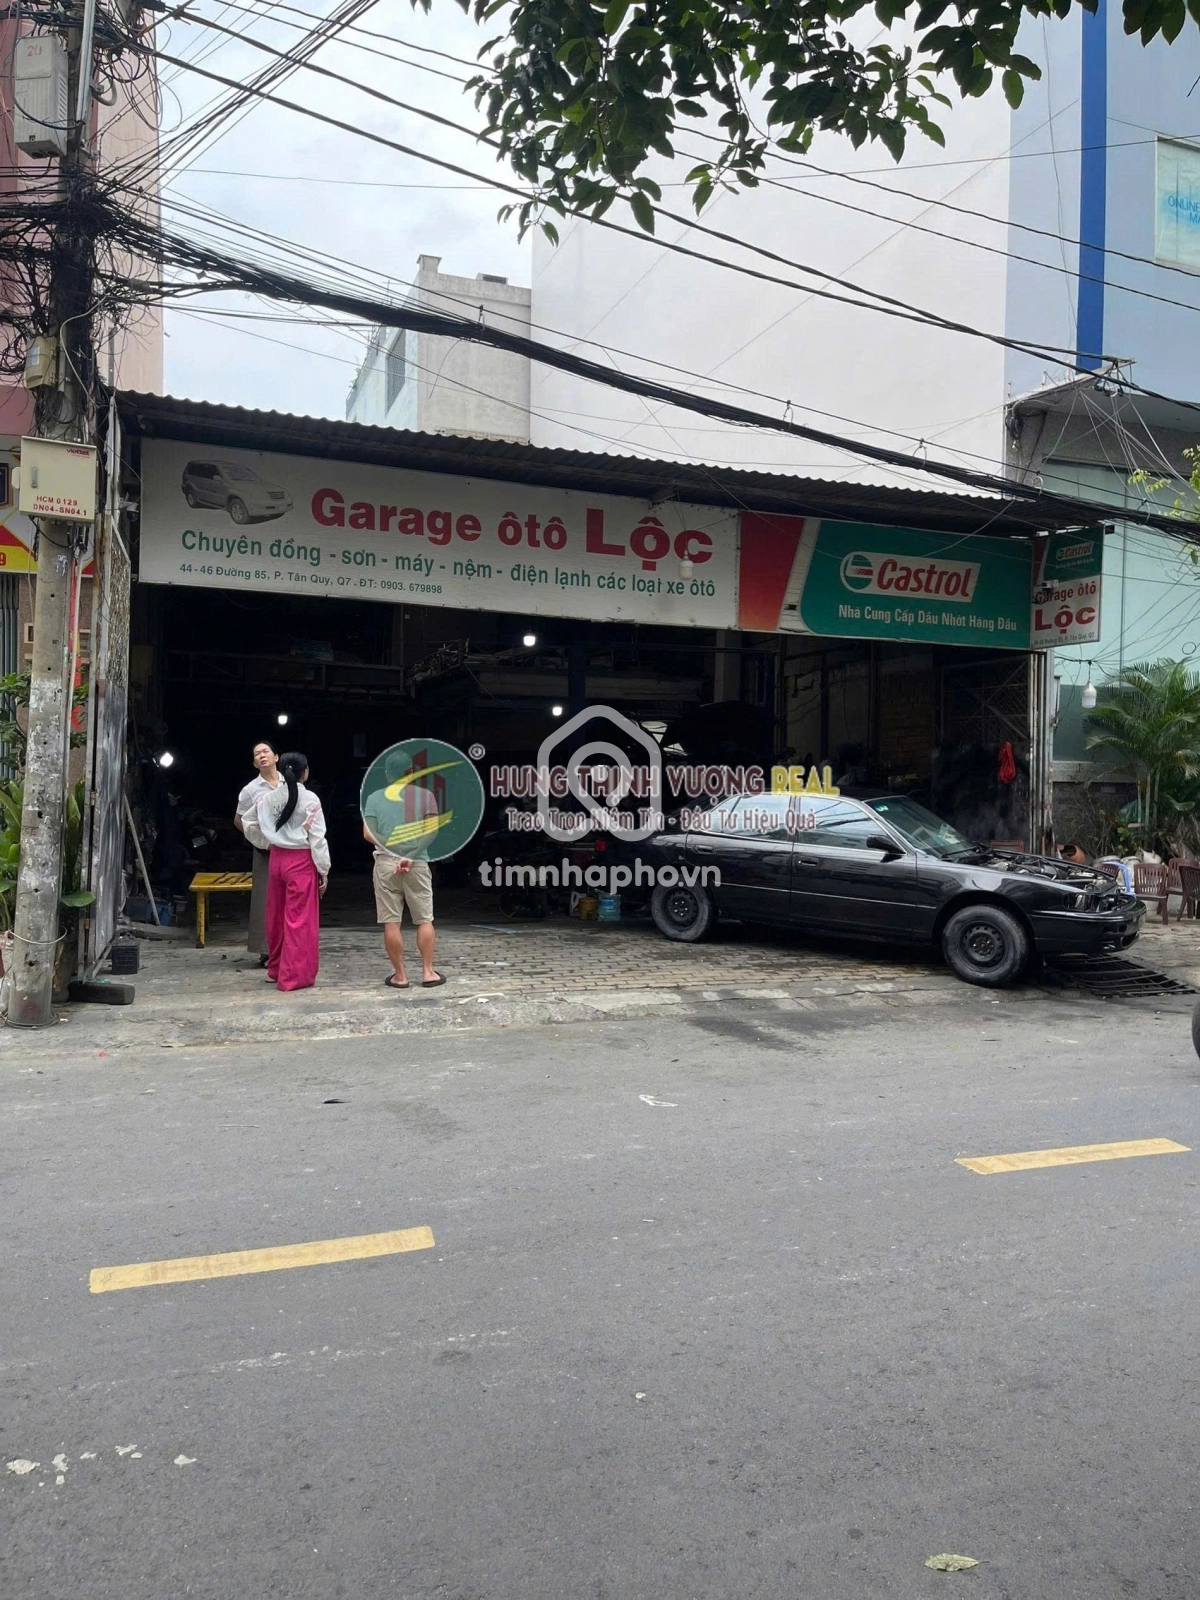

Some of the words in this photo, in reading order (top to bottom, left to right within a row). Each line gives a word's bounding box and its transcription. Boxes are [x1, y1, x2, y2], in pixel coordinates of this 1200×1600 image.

[56, 498, 78, 506] 0129
[311, 488, 482, 546] Garage
[498, 511, 568, 550] ôtô
[586, 508, 713, 571] Lộc
[1064, 542, 1092, 558] Castrol
[182, 529, 262, 558] Chuyên
[269, 538, 321, 566] đồng
[341, 549, 376, 567] sơn
[395, 553, 434, 577] máy
[453, 559, 492, 580] nệm
[510, 564, 548, 586] điện
[554, 567, 591, 590] lạnh
[597, 572, 626, 591] các
[632, 575, 663, 597] loại
[666, 581, 685, 594] xe
[690, 579, 716, 597] ôtô
[216, 566, 251, 580] Đường
[254, 570, 270, 580] 85,
[274, 571, 284, 580] P.
[288, 572, 307, 582] Tân
[310, 574, 333, 586] Quy,
[380, 580, 406, 591] 0903.
[409, 583, 443, 594] 679898
[877, 558, 972, 597] Castrol
[1034, 588, 1074, 602] Garage
[1078, 581, 1097, 597] ôtô
[838, 604, 860, 619] Nhà
[864, 606, 891, 624] Cung
[894, 608, 915, 625] Cấp
